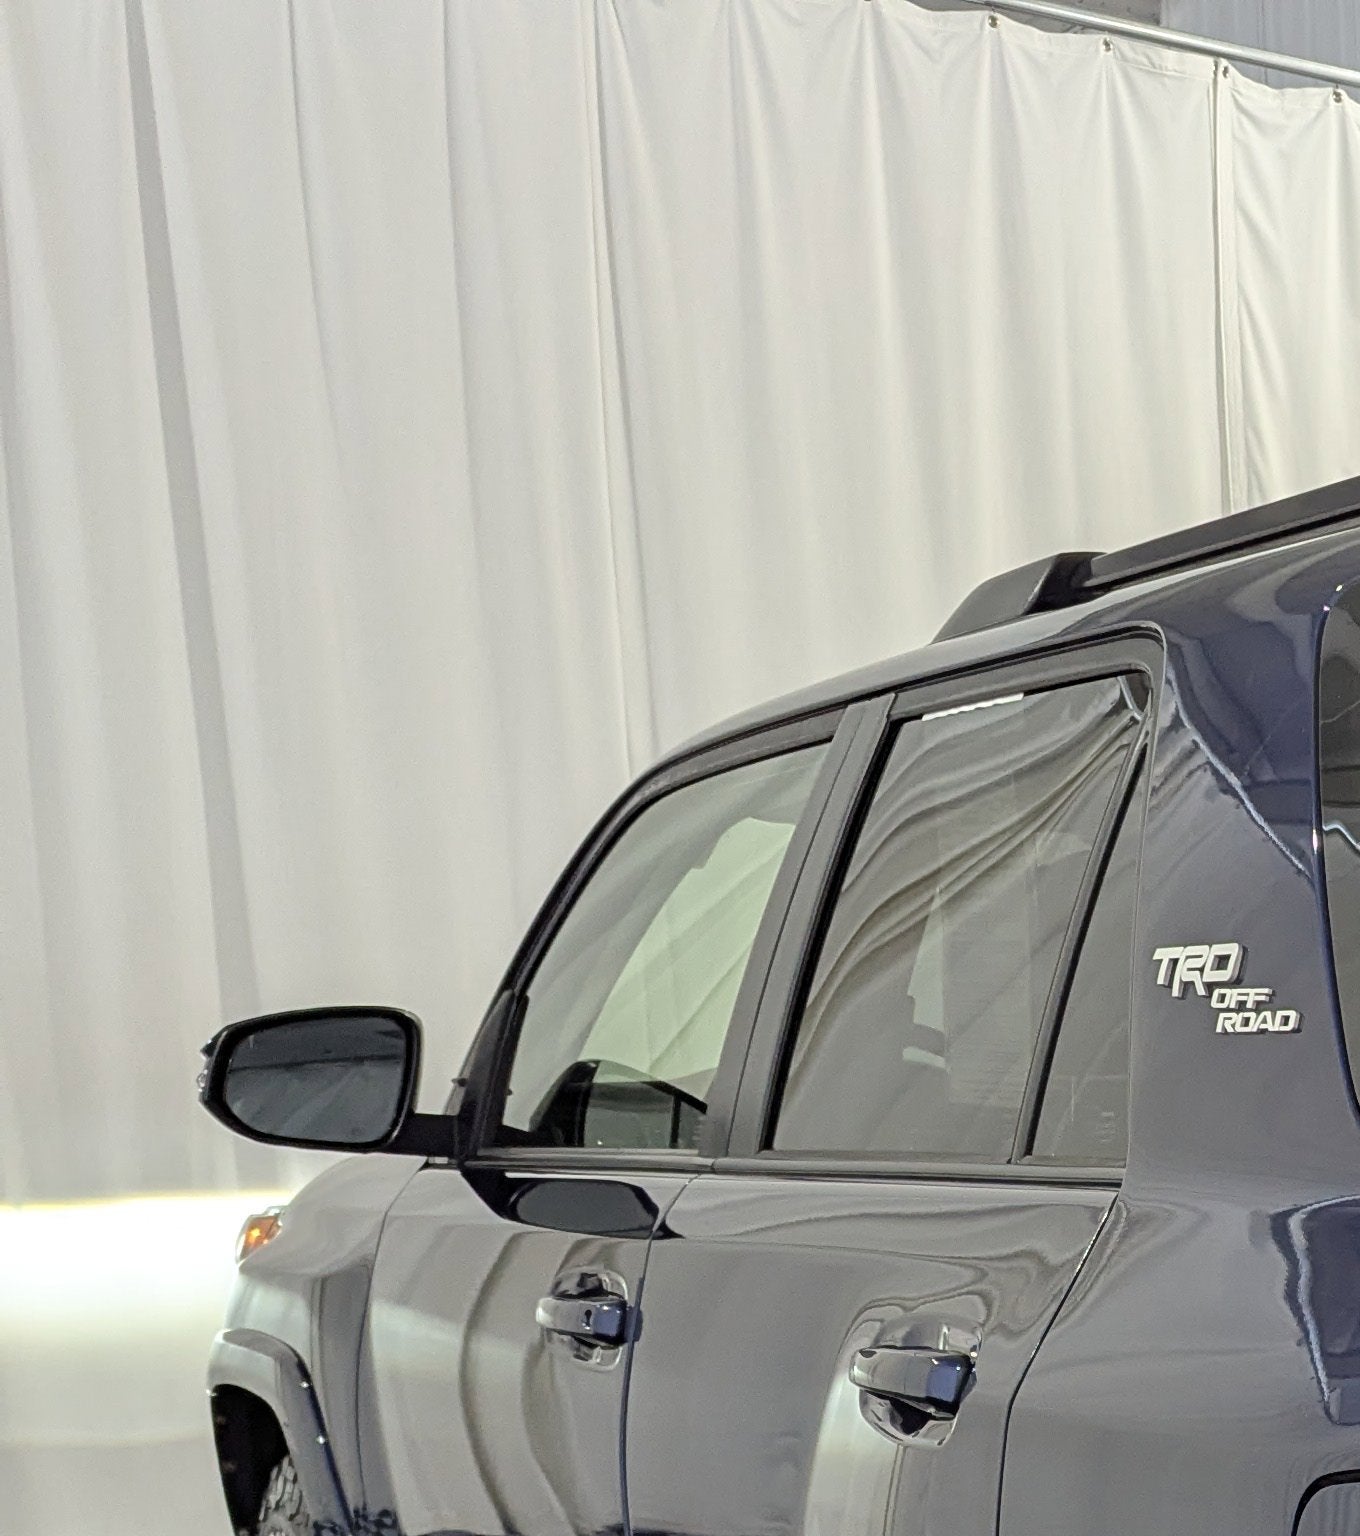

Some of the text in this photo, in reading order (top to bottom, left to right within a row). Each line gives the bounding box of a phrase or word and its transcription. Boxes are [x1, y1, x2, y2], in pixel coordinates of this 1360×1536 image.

[1152, 942, 1245, 998] TRD
[1210, 987, 1273, 1010] OFF
[1215, 1009, 1301, 1034] ROAD
